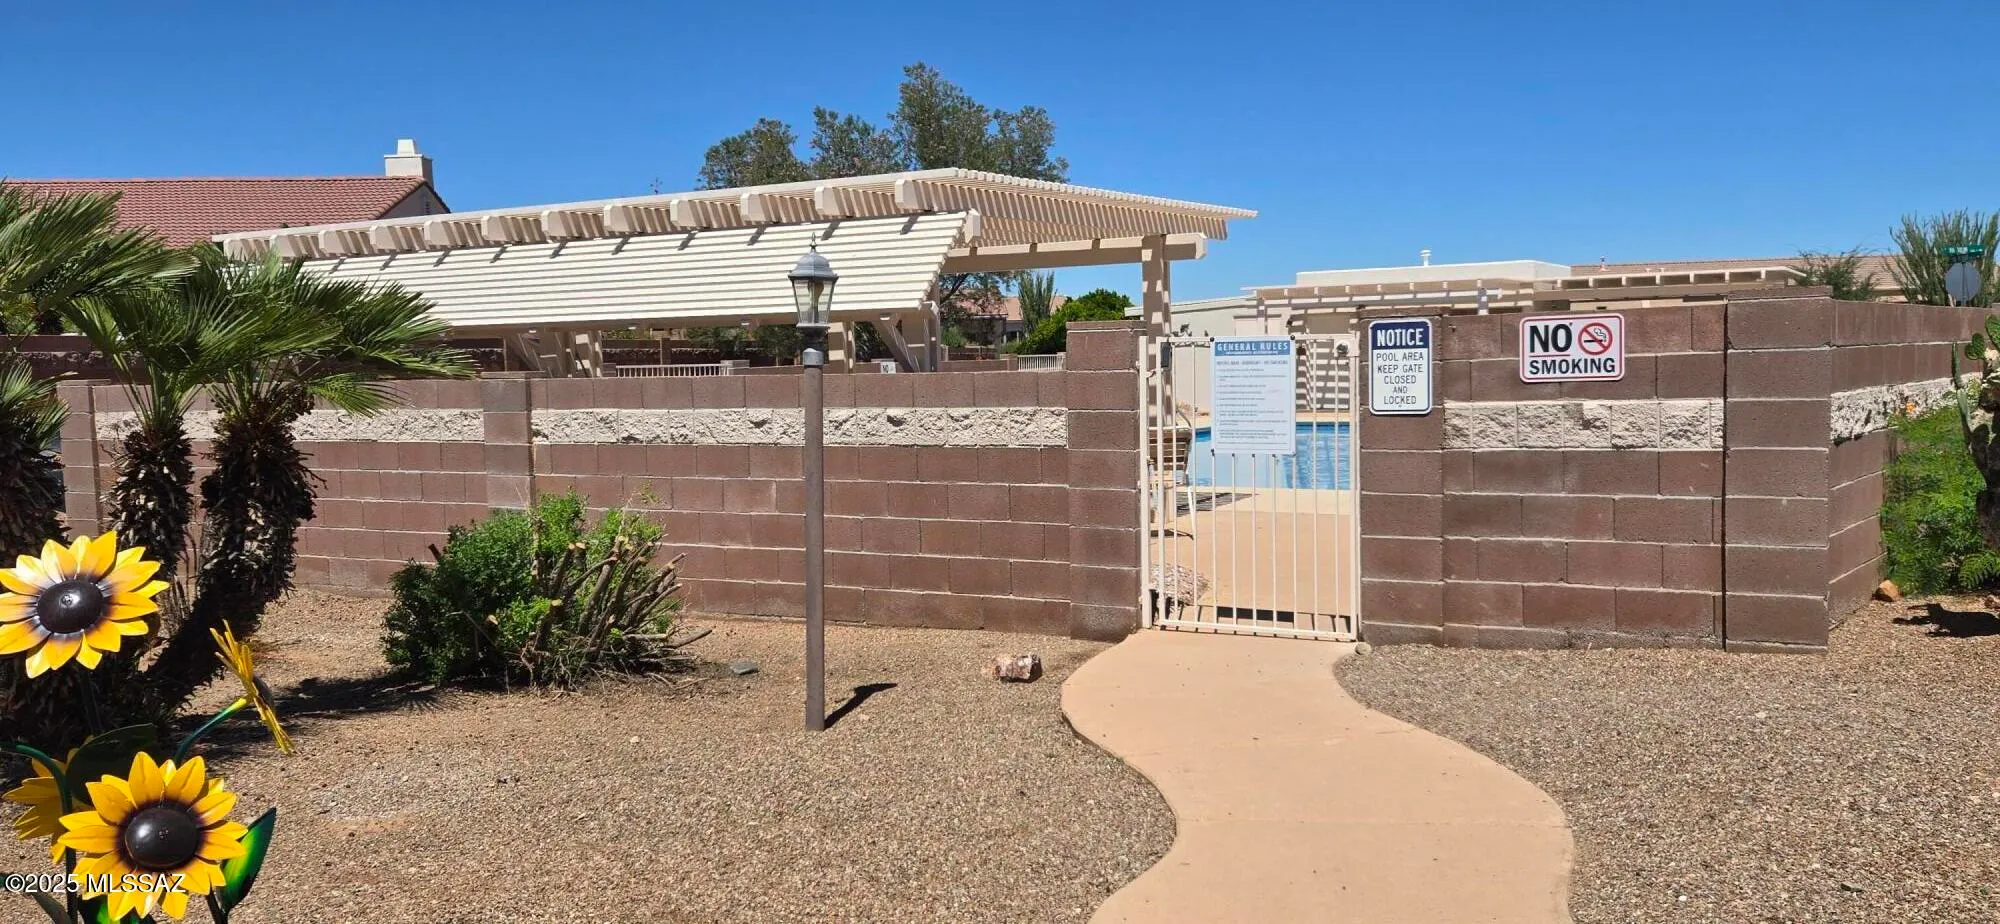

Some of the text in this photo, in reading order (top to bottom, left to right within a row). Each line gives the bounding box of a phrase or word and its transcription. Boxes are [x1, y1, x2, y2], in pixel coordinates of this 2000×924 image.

[1376, 328, 1424, 347] NOTICE
[1529, 323, 1573, 353] NO
[1217, 342, 1289, 351] GENERAL RULES
[1376, 352, 1424, 362] POOL AREA
[1377, 364, 1424, 374] KEEP GATE
[1528, 357, 1616, 375] SMOKING
[1384, 375, 1417, 385] CLOSED
[1393, 386, 1408, 394] AND
[1384, 395, 1417, 405] LOCKED
